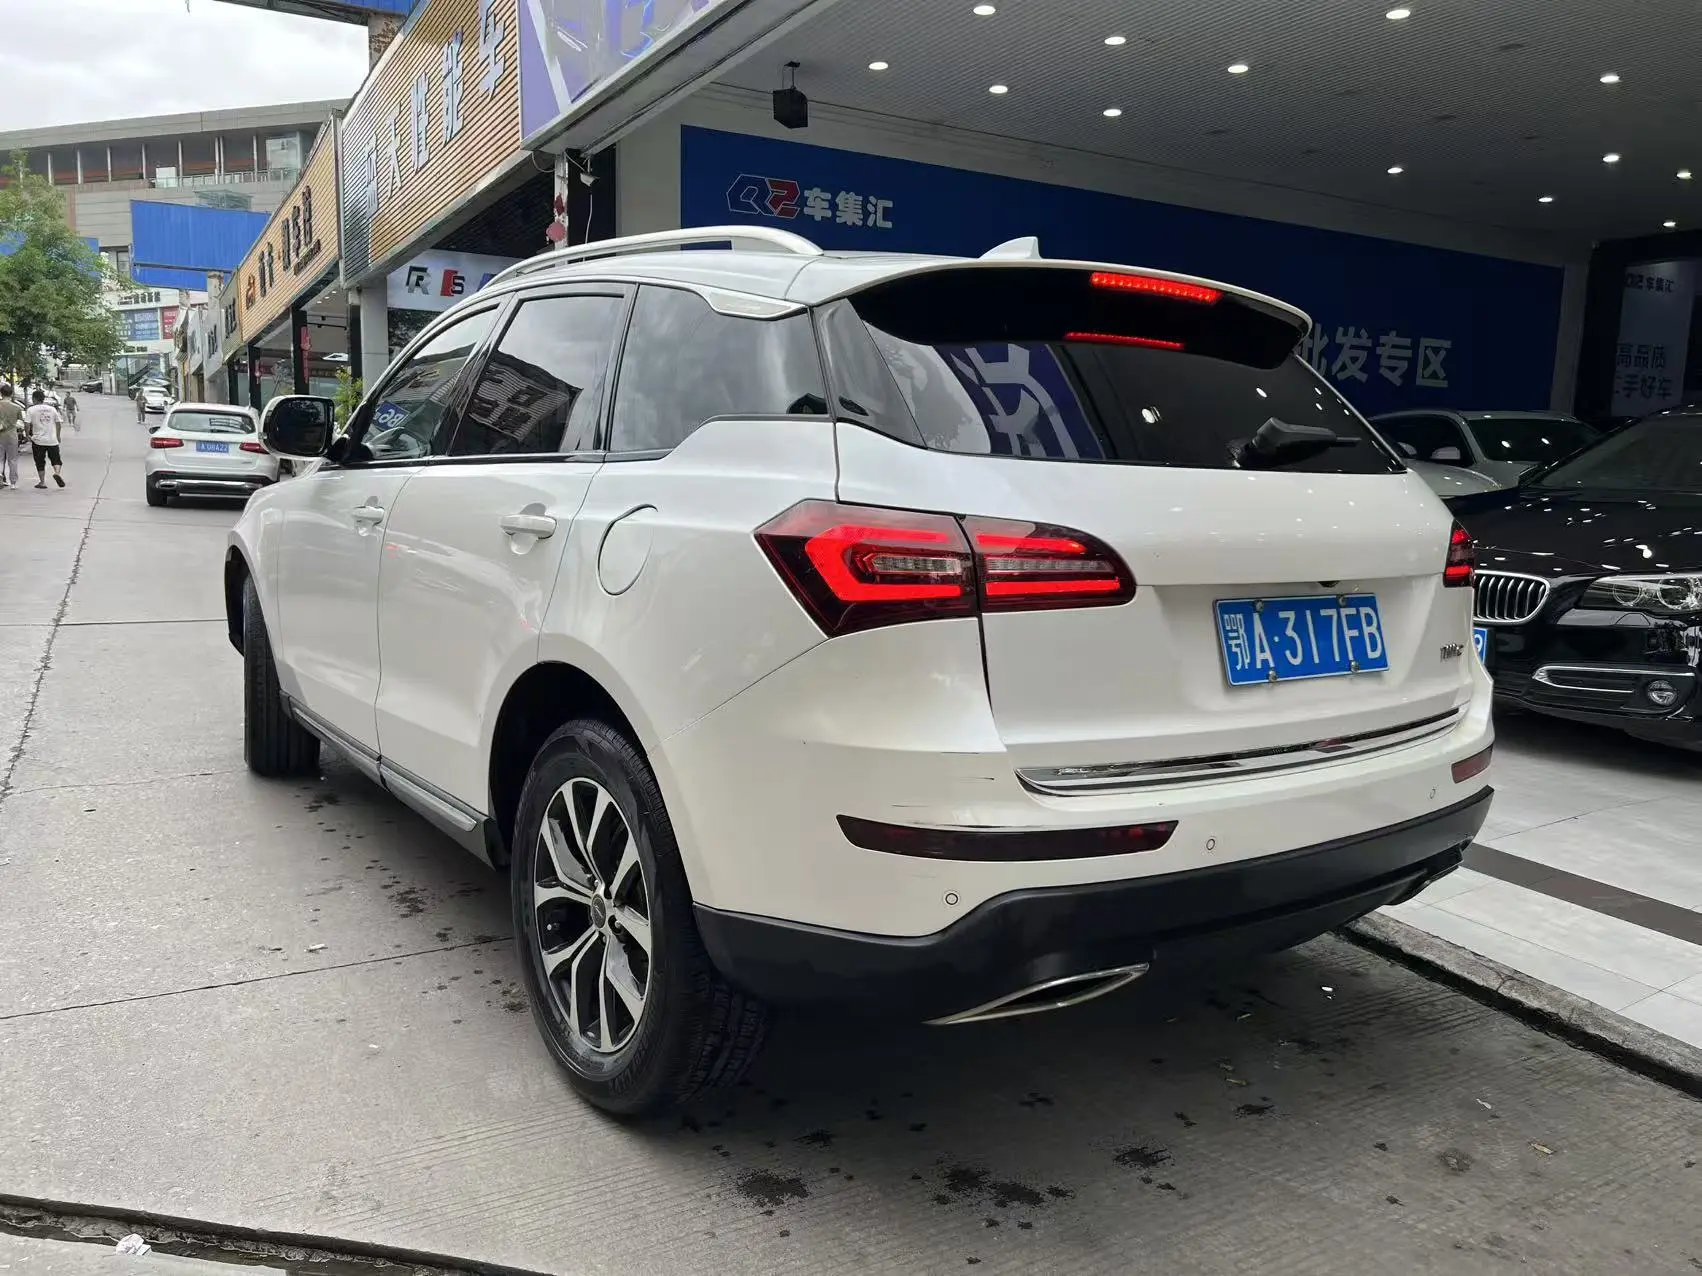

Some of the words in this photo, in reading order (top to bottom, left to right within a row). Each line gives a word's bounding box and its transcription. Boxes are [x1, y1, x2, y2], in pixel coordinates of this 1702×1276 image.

[803, 187, 893, 228] 车集汇
[1300, 323, 1452, 388] 批发专区
[1616, 342, 1666, 370] 高品质
